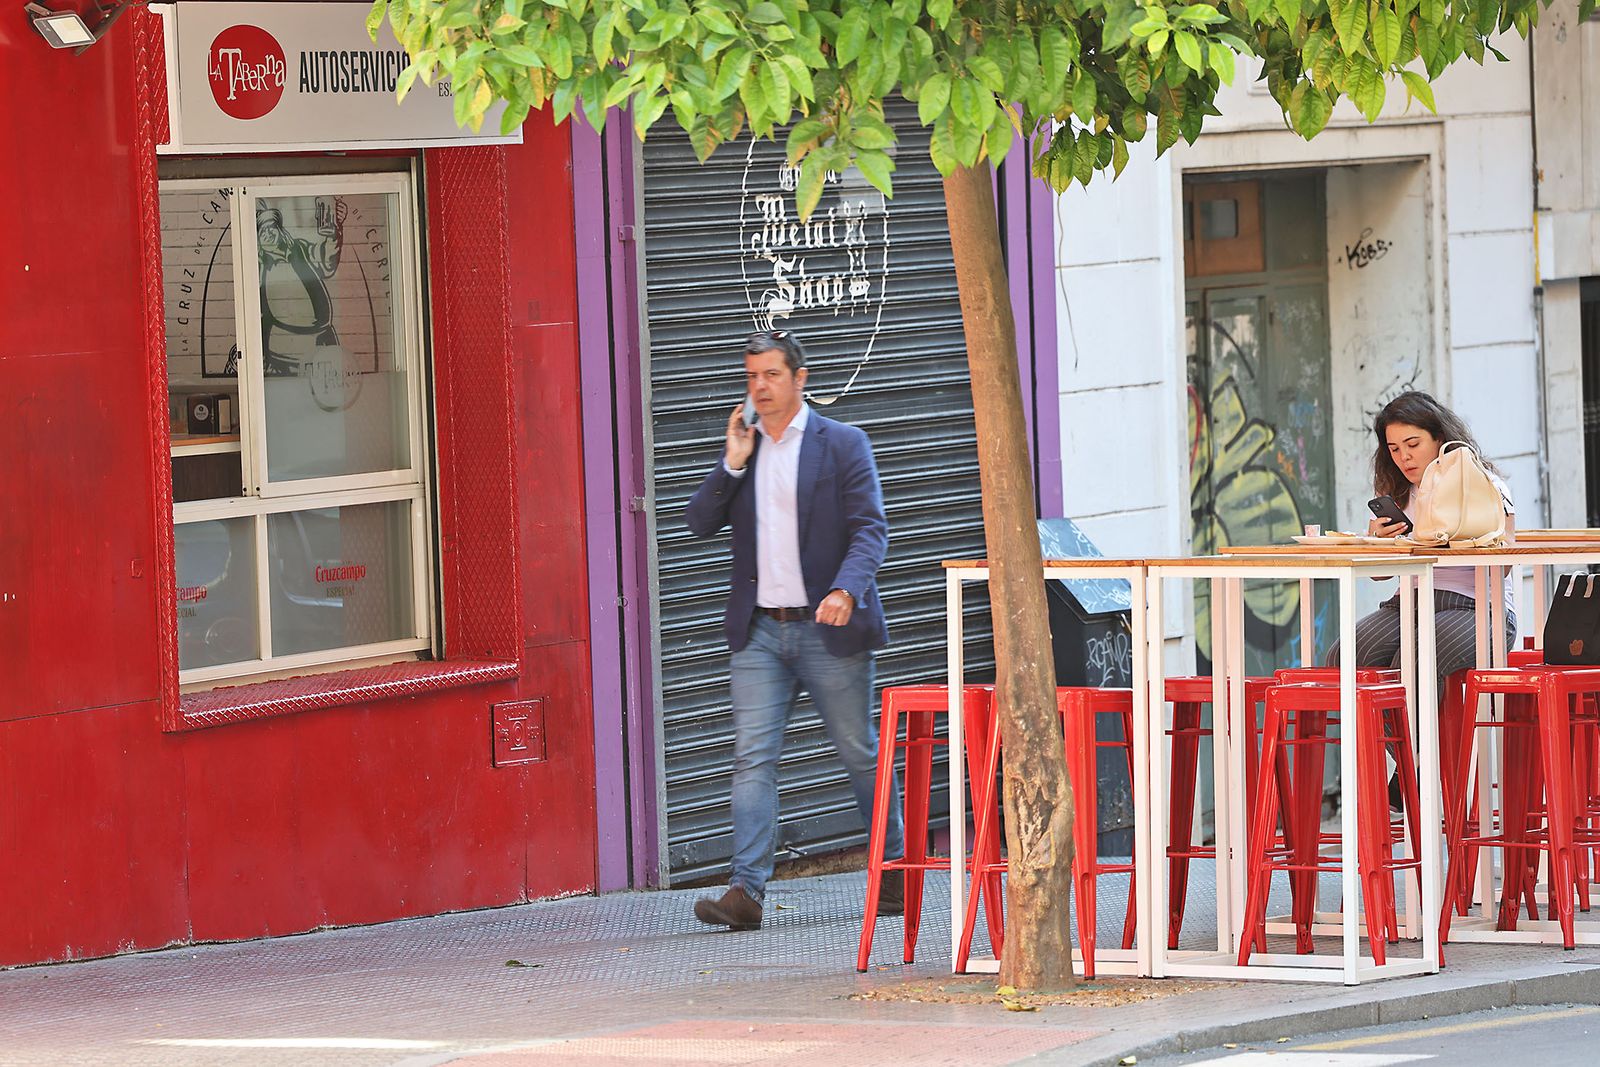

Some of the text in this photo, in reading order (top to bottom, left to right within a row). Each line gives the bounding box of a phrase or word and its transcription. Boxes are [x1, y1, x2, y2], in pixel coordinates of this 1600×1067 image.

[177, 268, 195, 326] CRUZ
[194, 235, 205, 255] DEL
[315, 564, 367, 584] Cruzcampo
